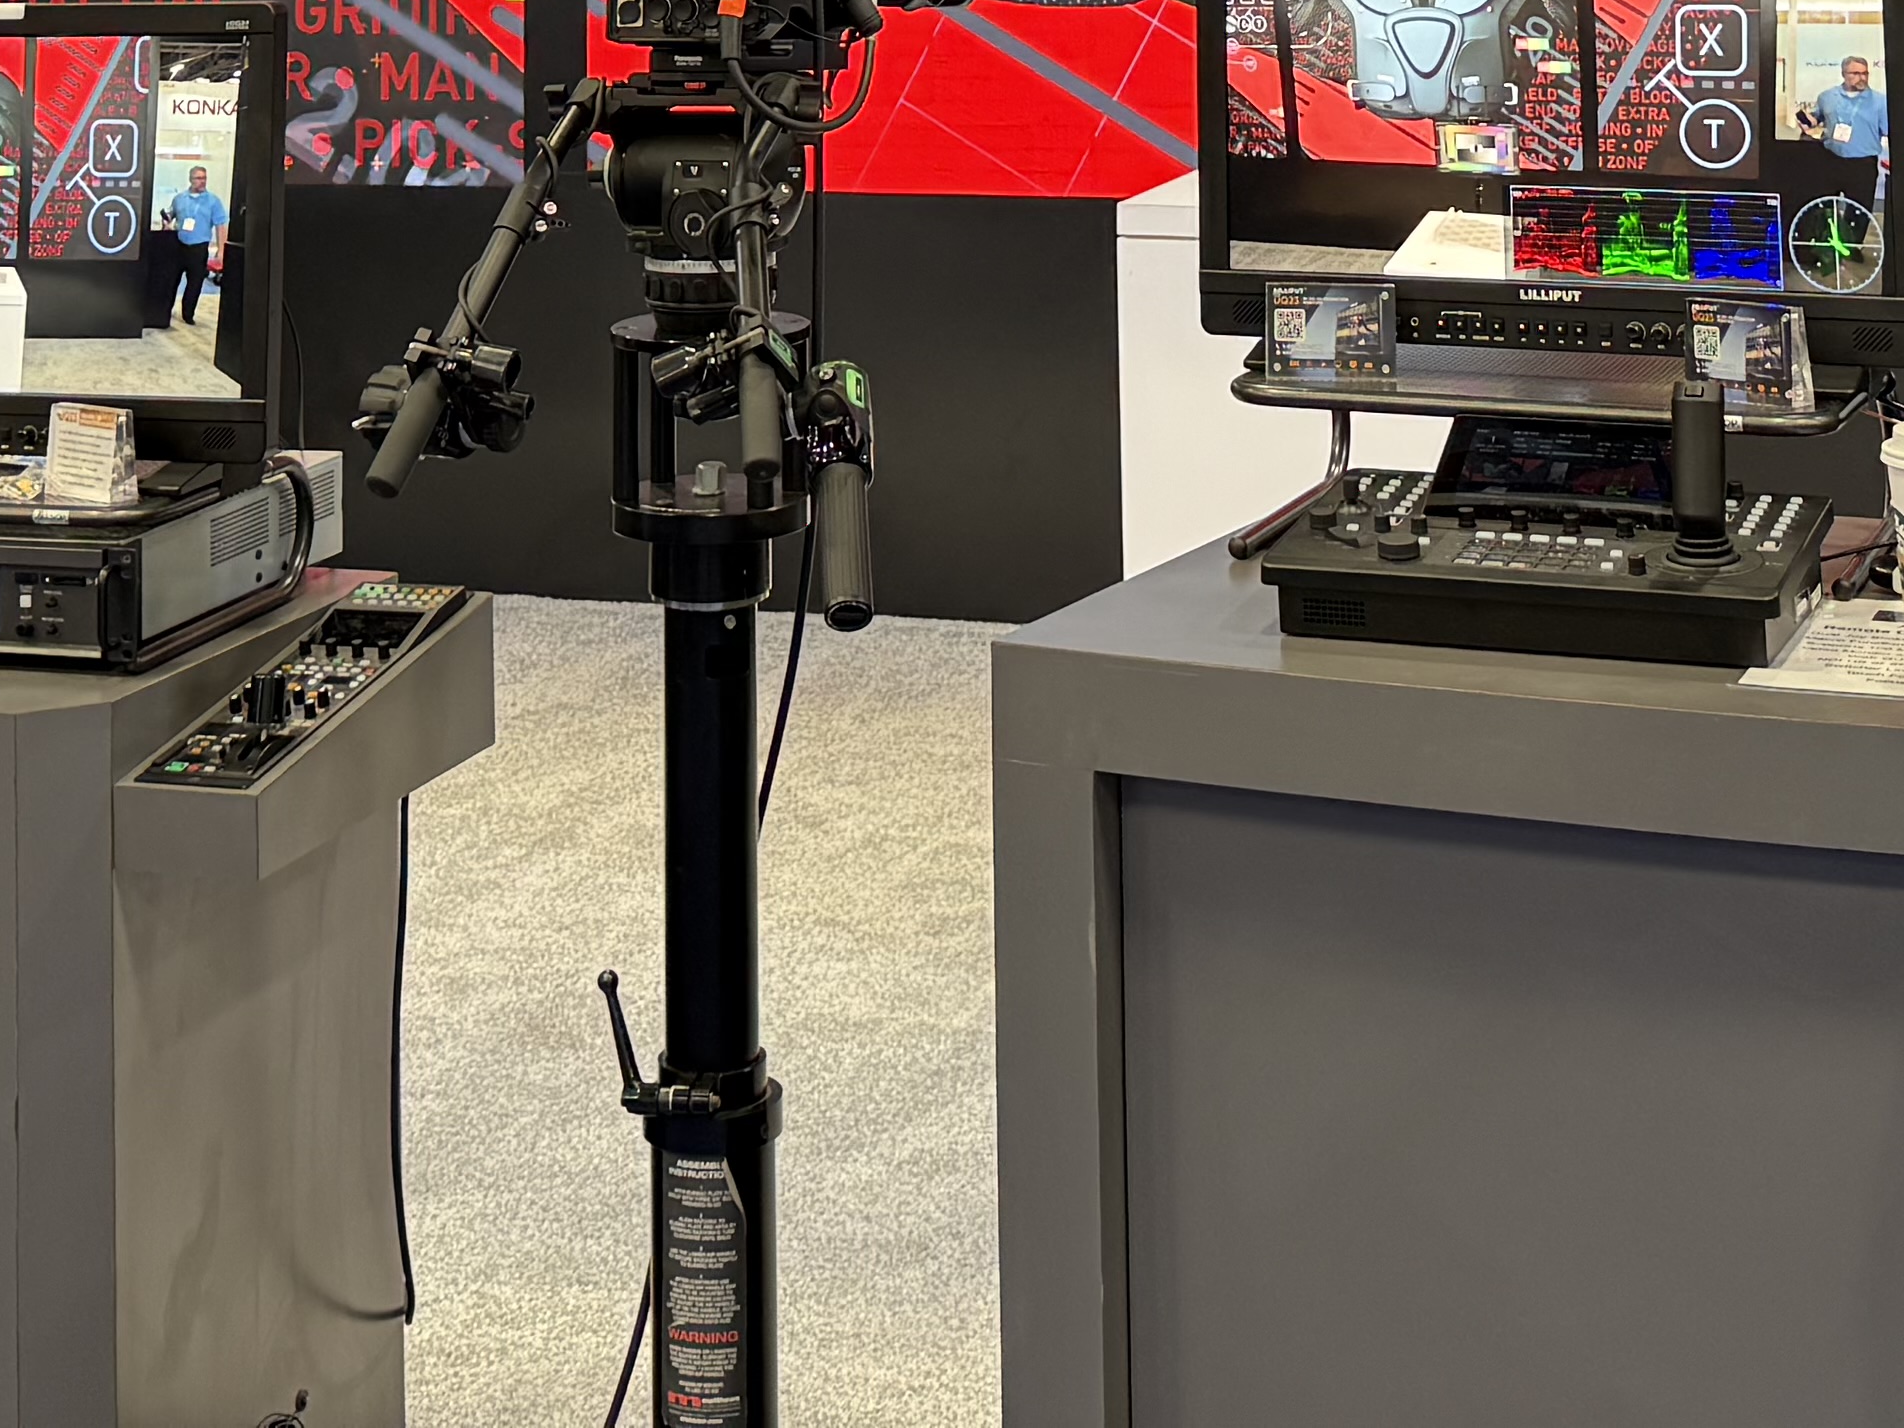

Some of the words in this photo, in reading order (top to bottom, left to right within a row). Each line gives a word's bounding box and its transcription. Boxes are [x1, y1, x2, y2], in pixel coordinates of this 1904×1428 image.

[1699, 23, 1725, 57] X
[1618, 105, 1671, 121] EXTRA
[1703, 118, 1726, 149] T
[104, 134, 122, 161] X
[104, 212, 120, 237] T
[1519, 289, 1582, 303] LILLIPUT
[668, 1328, 740, 1344] WARNING
